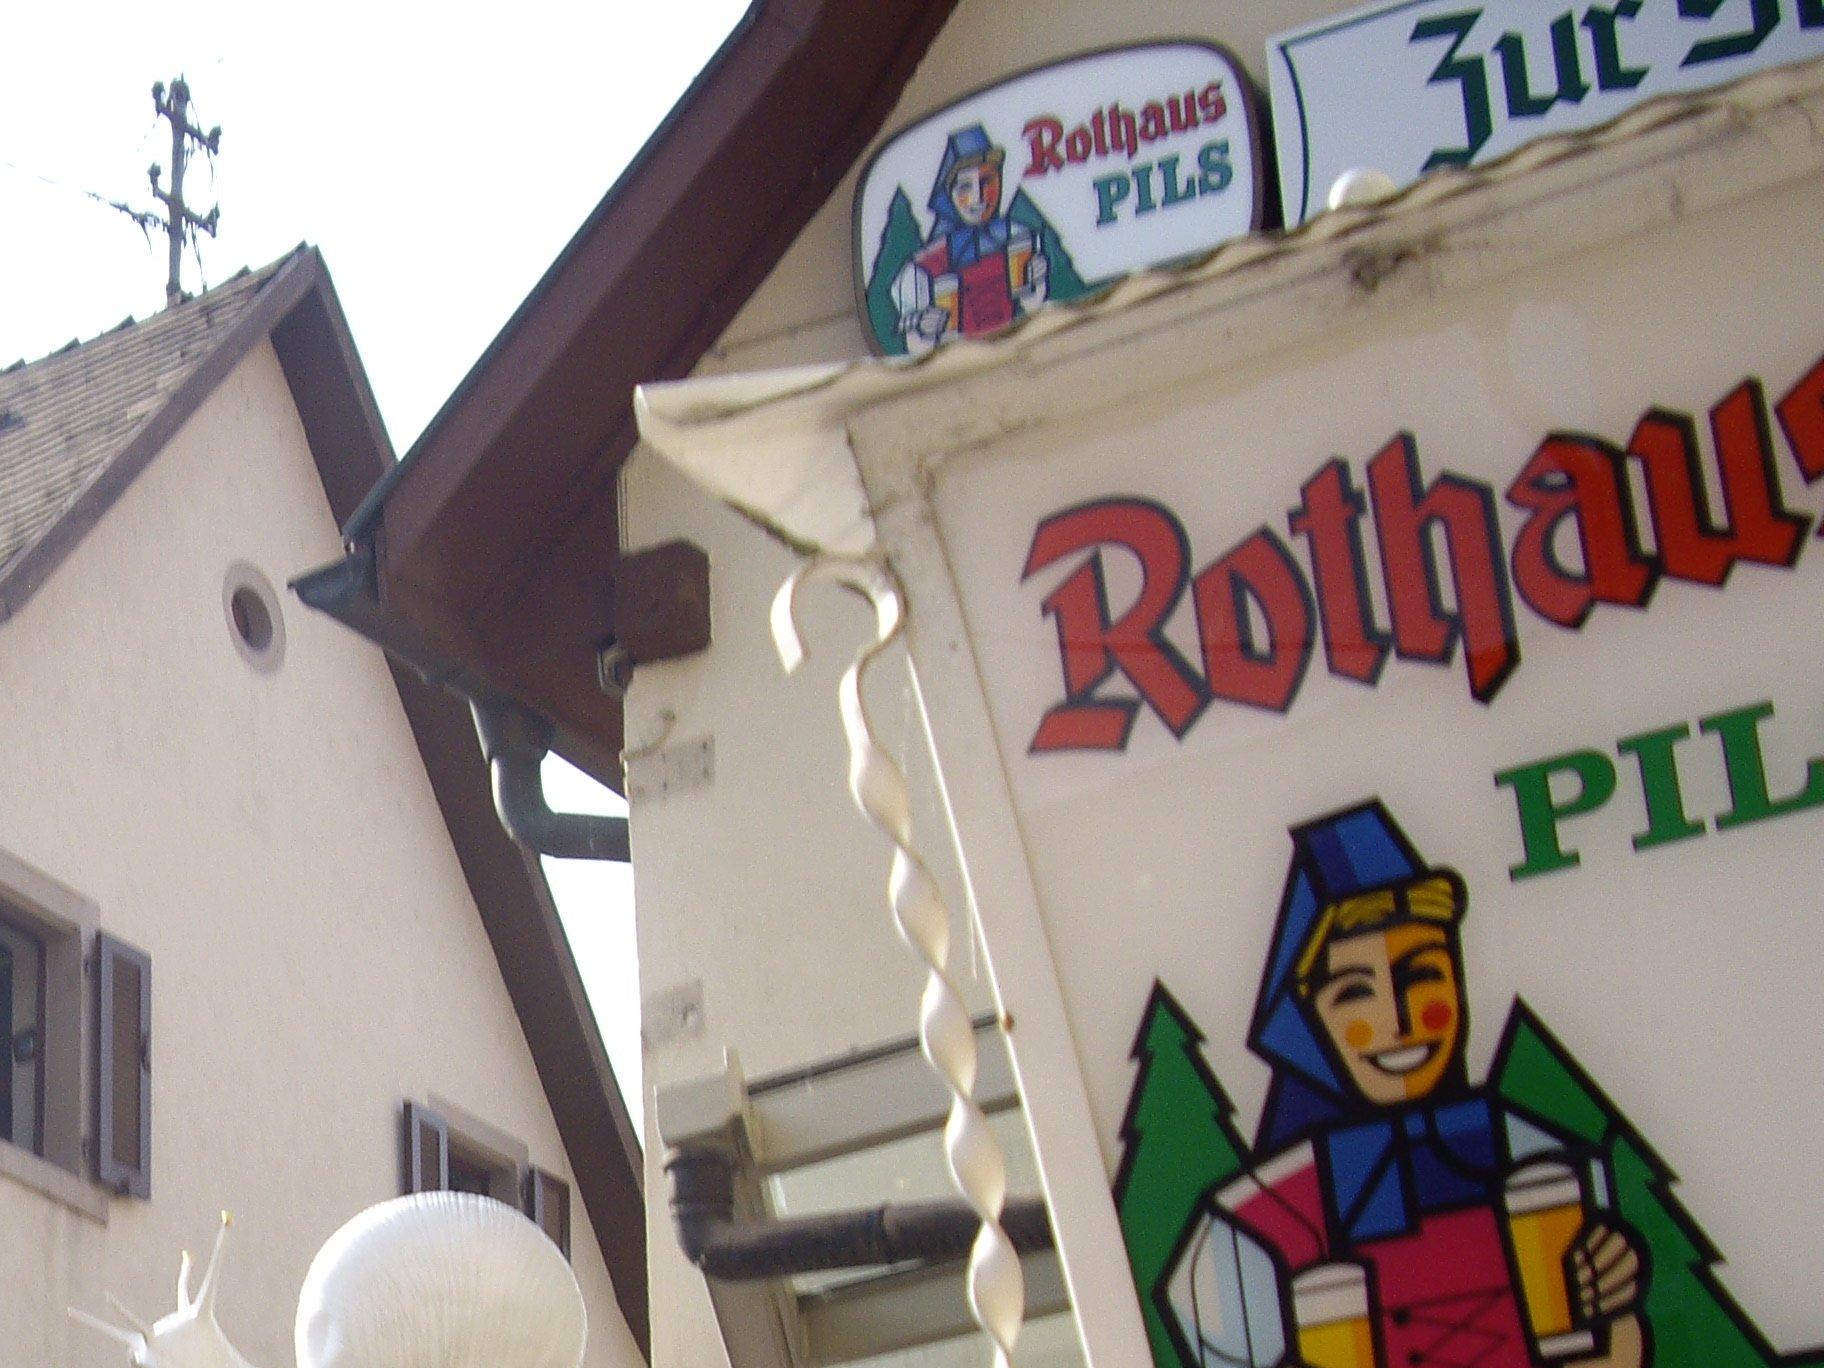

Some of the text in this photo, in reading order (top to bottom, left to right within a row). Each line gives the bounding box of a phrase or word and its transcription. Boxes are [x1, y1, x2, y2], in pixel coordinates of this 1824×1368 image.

[1022, 79, 1227, 178] Rothaus
[1409, 0, 1650, 174] Zur
[1093, 138, 1233, 227] PILS
